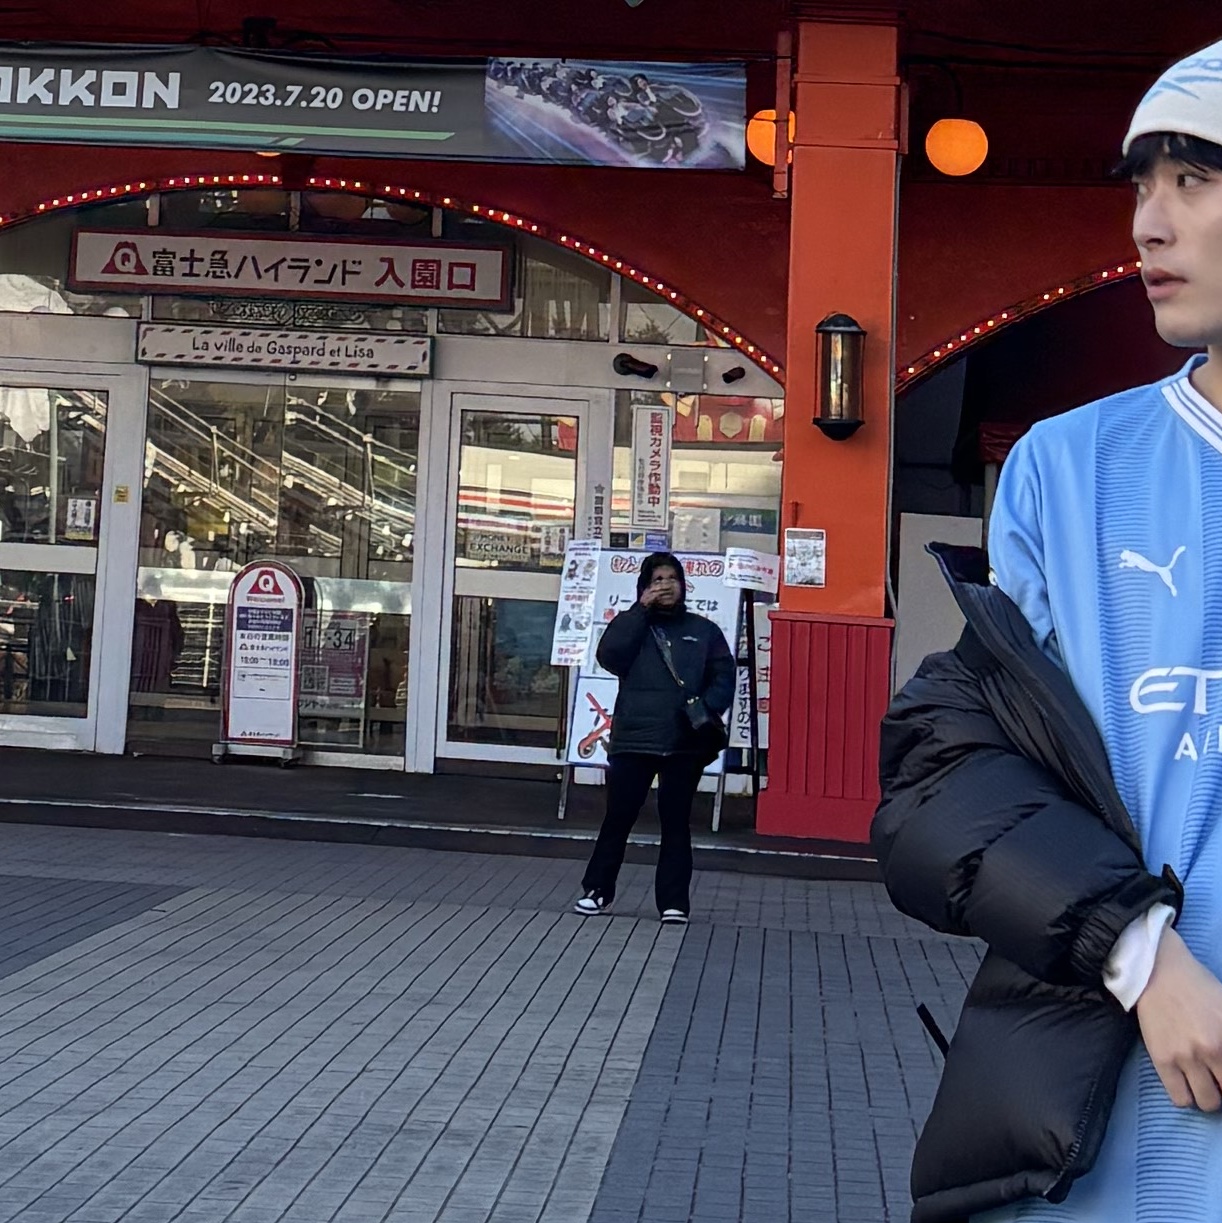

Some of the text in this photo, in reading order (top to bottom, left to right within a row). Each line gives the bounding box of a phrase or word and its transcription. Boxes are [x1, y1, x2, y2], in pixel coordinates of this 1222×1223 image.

[208, 81, 441, 113] 2023.7.20 OPEN!
[151, 249, 477, 291] 富士急ハイランド 入園口
[193, 337, 209, 350] La
[213, 338, 243, 353] ville
[266, 341, 325, 363] Gaspard
[345, 345, 375, 359] Lisa
